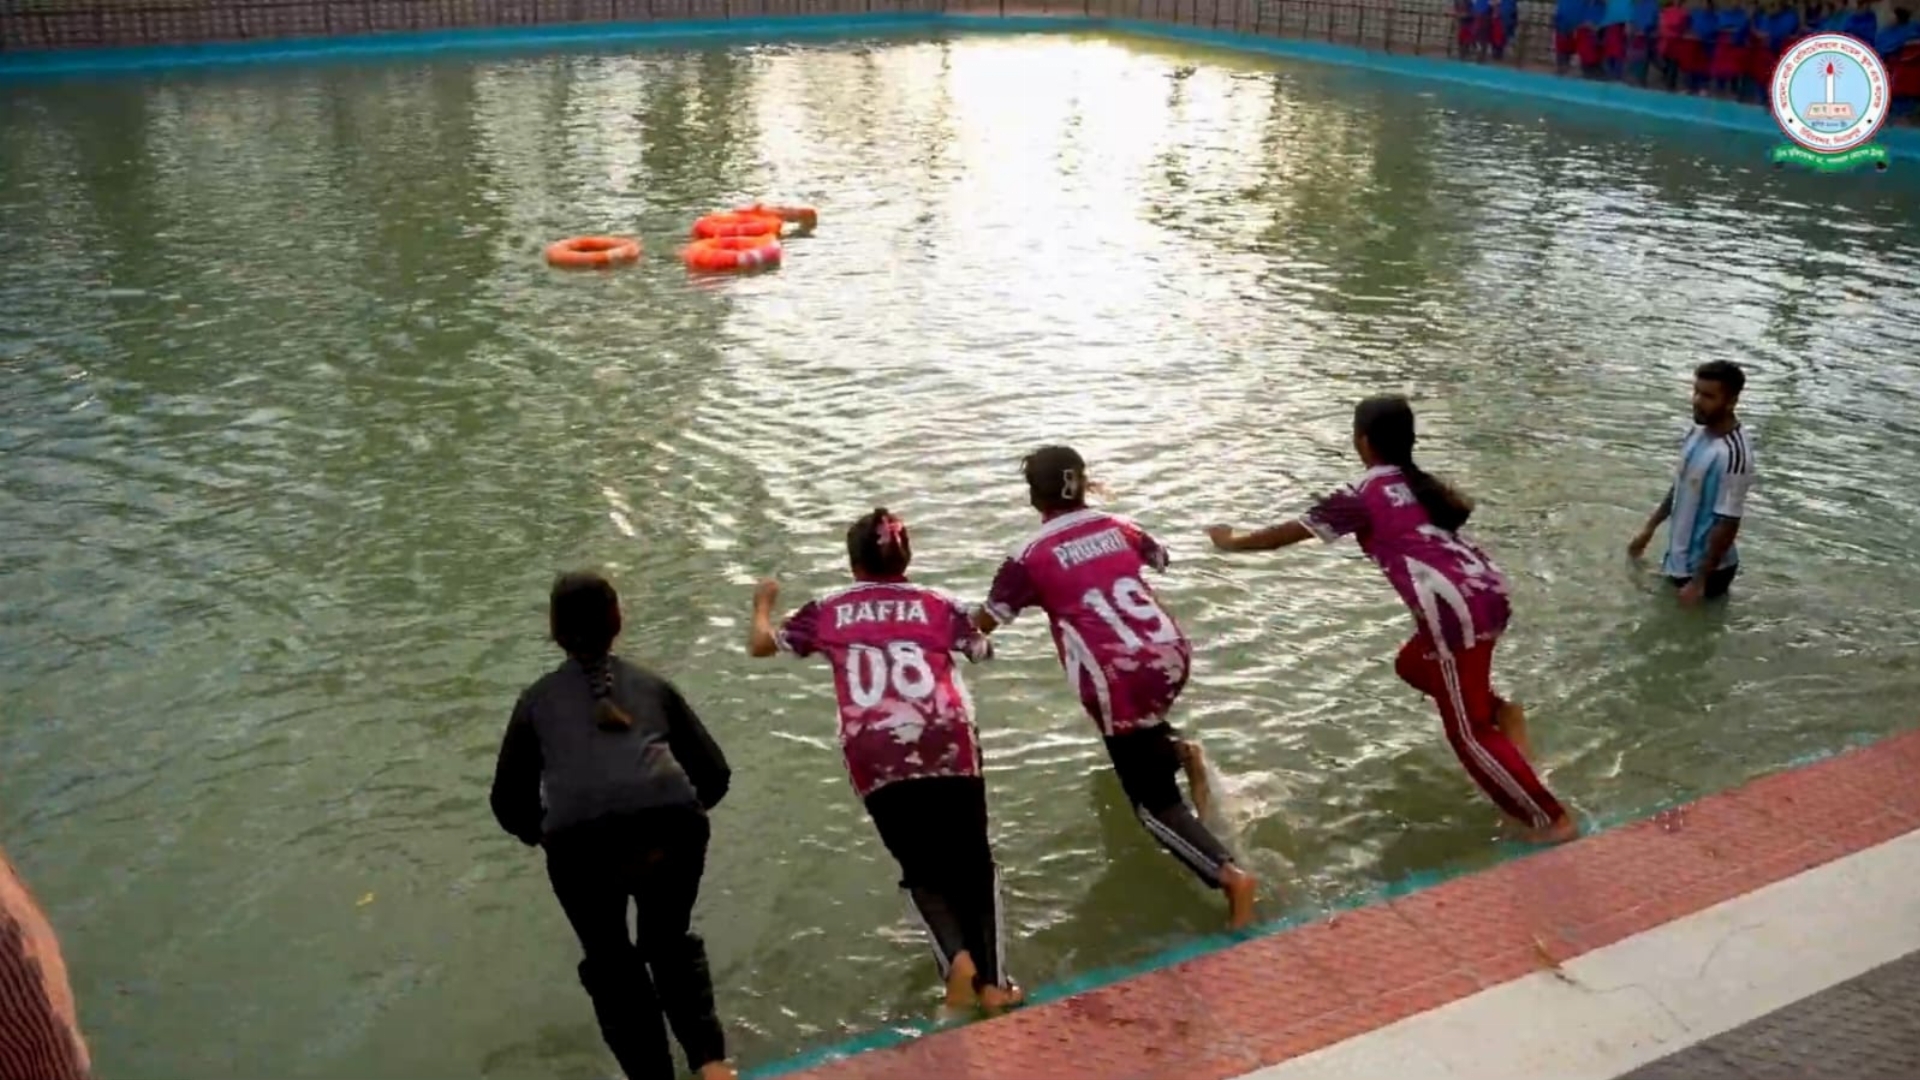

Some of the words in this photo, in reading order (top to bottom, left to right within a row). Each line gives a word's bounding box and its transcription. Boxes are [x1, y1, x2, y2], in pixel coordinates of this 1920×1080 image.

[834, 600, 929, 630] RAFIA
[1083, 577, 1182, 649] 19
[846, 641, 935, 708] 08
